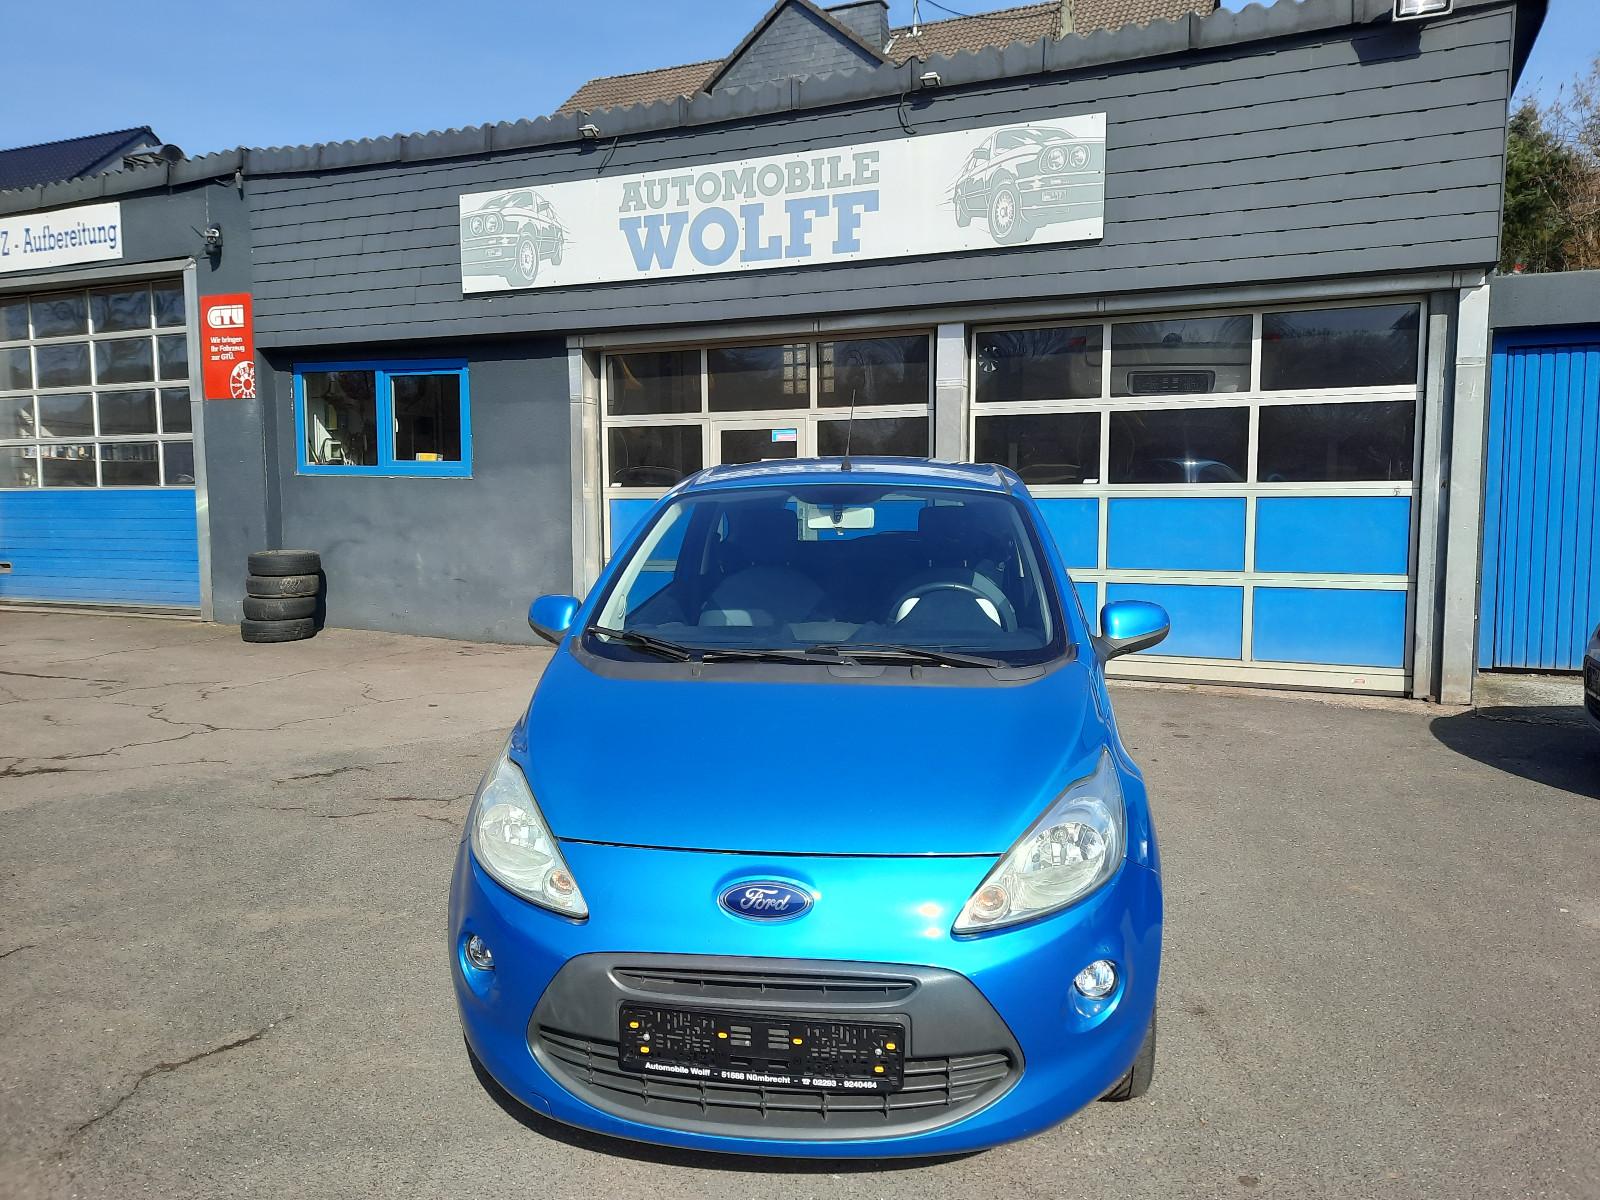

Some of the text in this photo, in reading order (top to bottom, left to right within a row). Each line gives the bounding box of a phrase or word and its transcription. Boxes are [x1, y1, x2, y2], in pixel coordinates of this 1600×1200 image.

[619, 151, 879, 212] AUTOMOBILE
[23, 221, 117, 254] Aufbereitung
[619, 190, 879, 272] WOLFF
[221, 336, 242, 344] bringen
[740, 888, 791, 911] Ford
[645, 1062, 689, 1074] Automobile
[690, 1067, 711, 1076] Wolff
[746, 1073, 791, 1084] Nümbrecht
[812, 1078, 837, 1087] 02293
